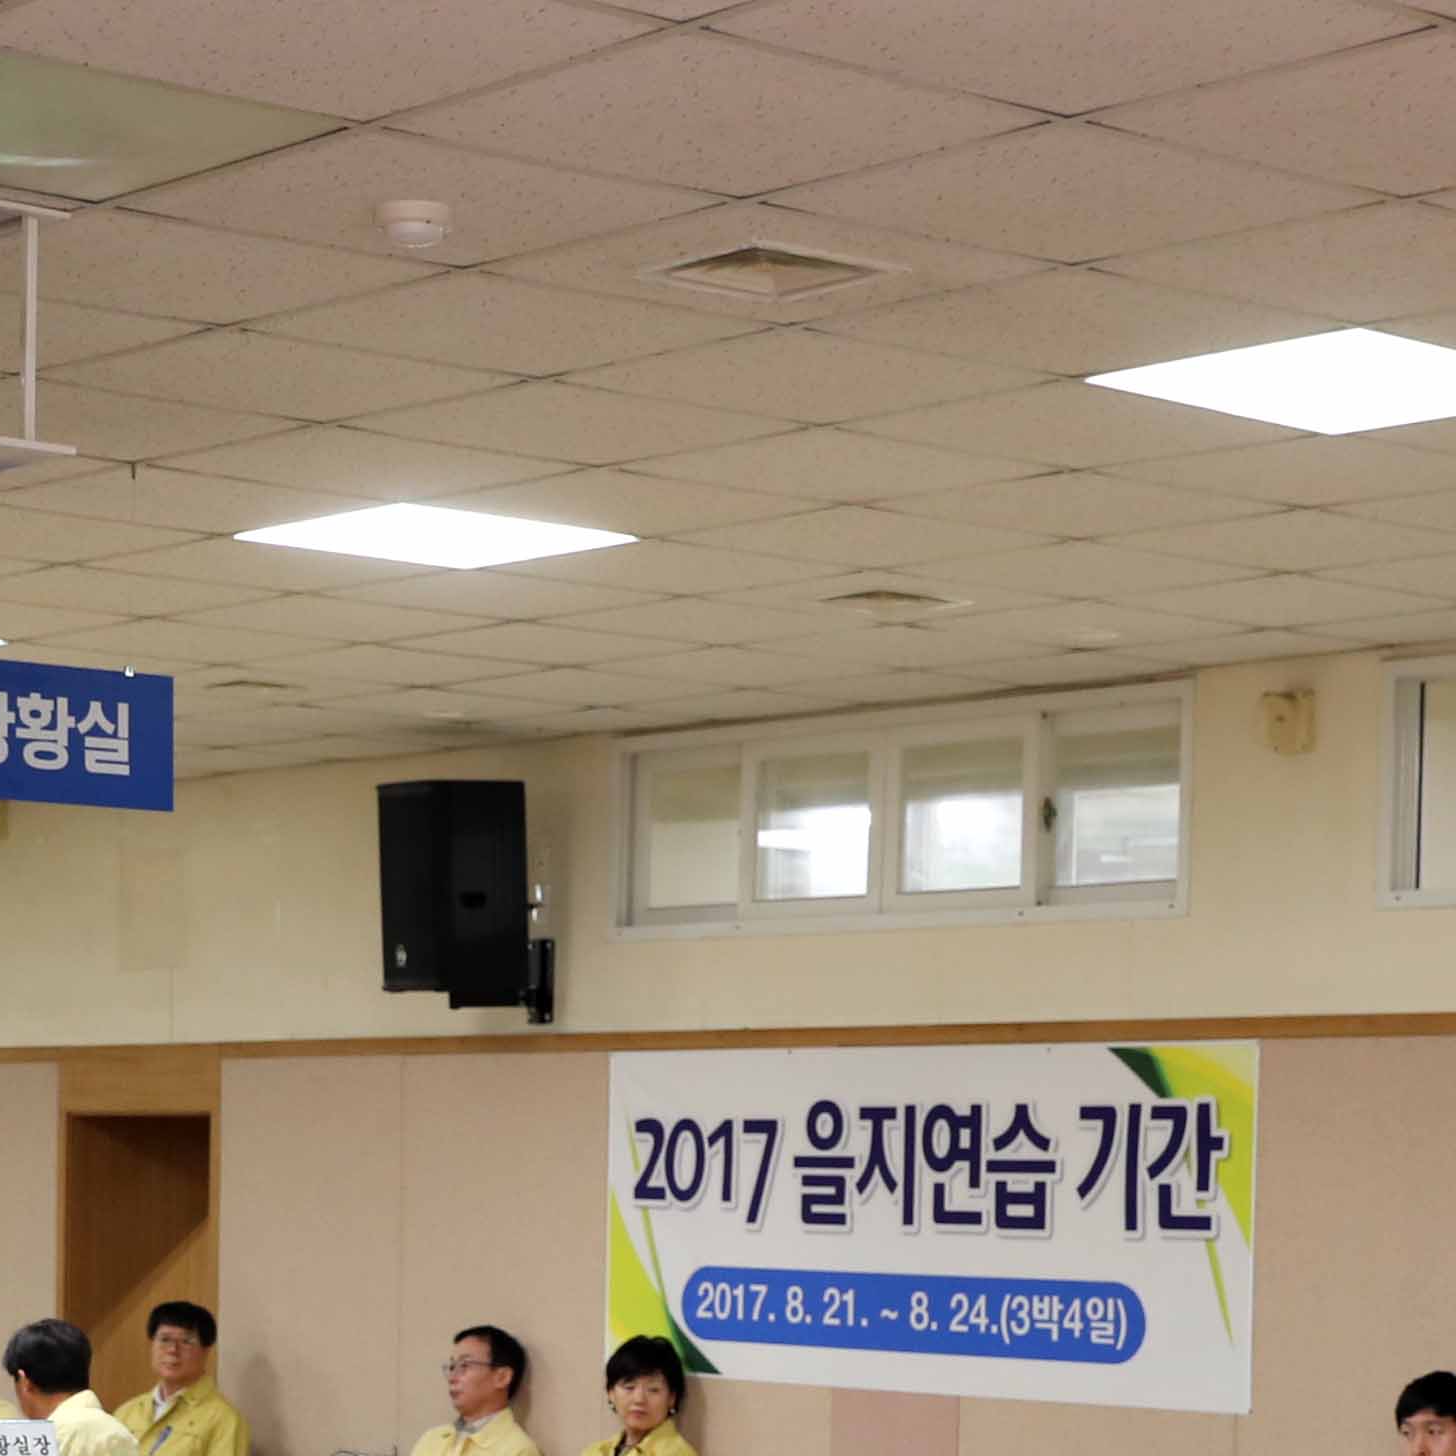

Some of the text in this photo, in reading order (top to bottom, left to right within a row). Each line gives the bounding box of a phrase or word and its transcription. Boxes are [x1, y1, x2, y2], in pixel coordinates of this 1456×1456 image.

[633, 1099, 1226, 1232] 2017 을지연습 기간
[695, 1281, 777, 1323] 2017.
[785, 1285, 813, 1325] 8.
[821, 1287, 869, 1328] 21.
[909, 1290, 938, 1331] 8.
